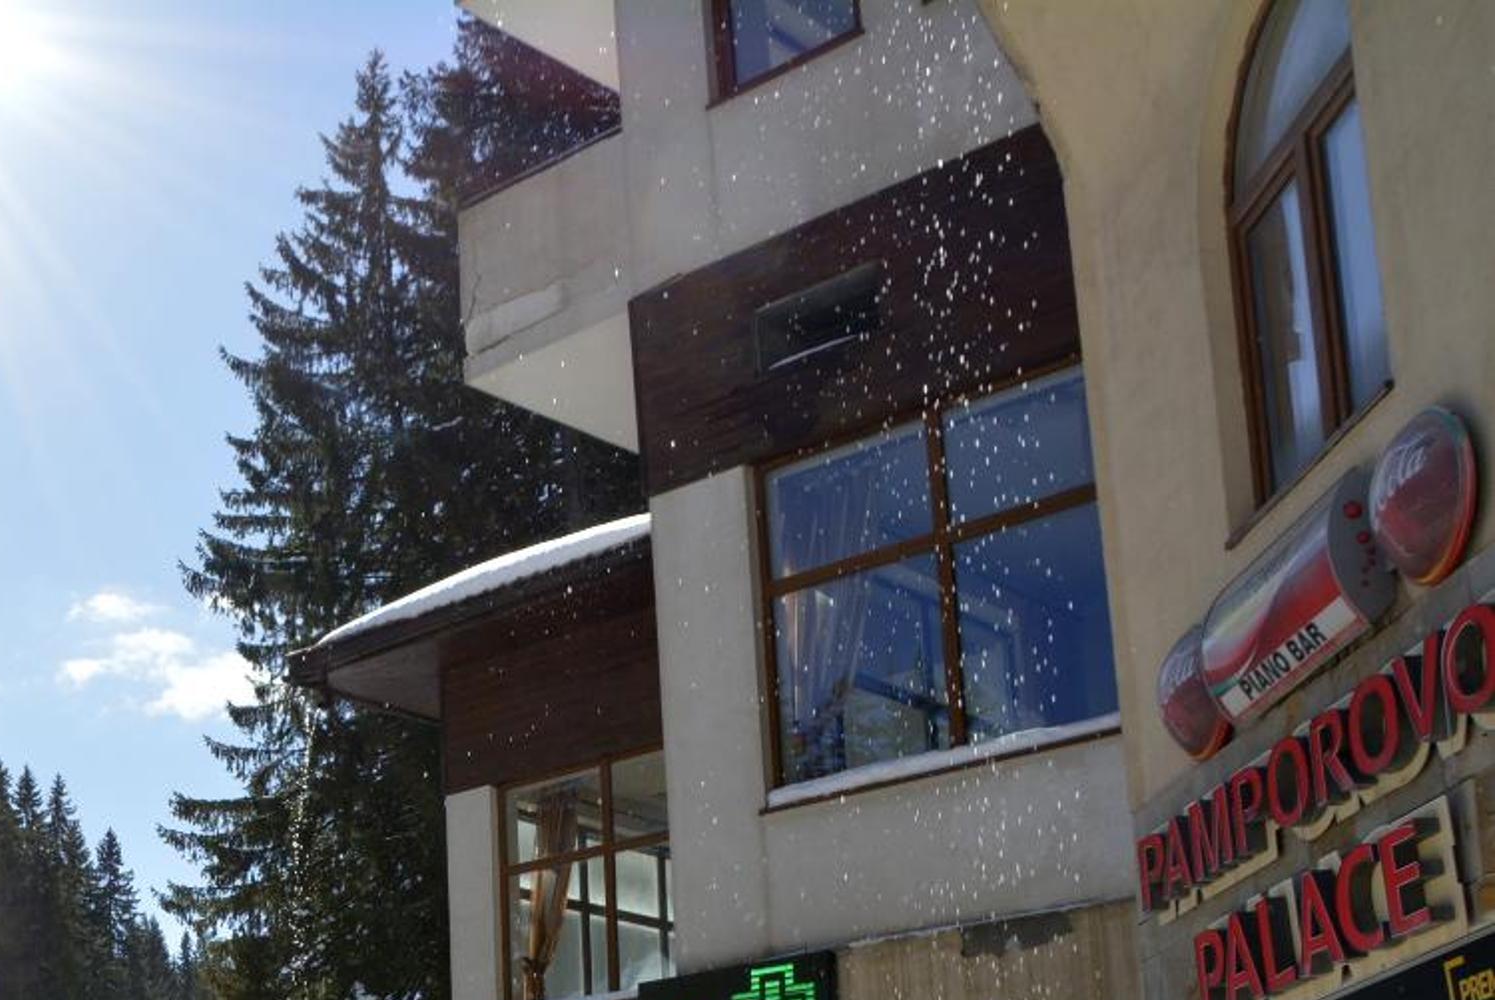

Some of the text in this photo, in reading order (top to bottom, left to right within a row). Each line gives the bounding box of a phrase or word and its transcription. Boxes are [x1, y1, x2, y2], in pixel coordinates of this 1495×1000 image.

[1136, 603, 1495, 912] PAMPOROVO
[1239, 654, 1291, 701] PIANO
[1287, 622, 1328, 661] BAR
